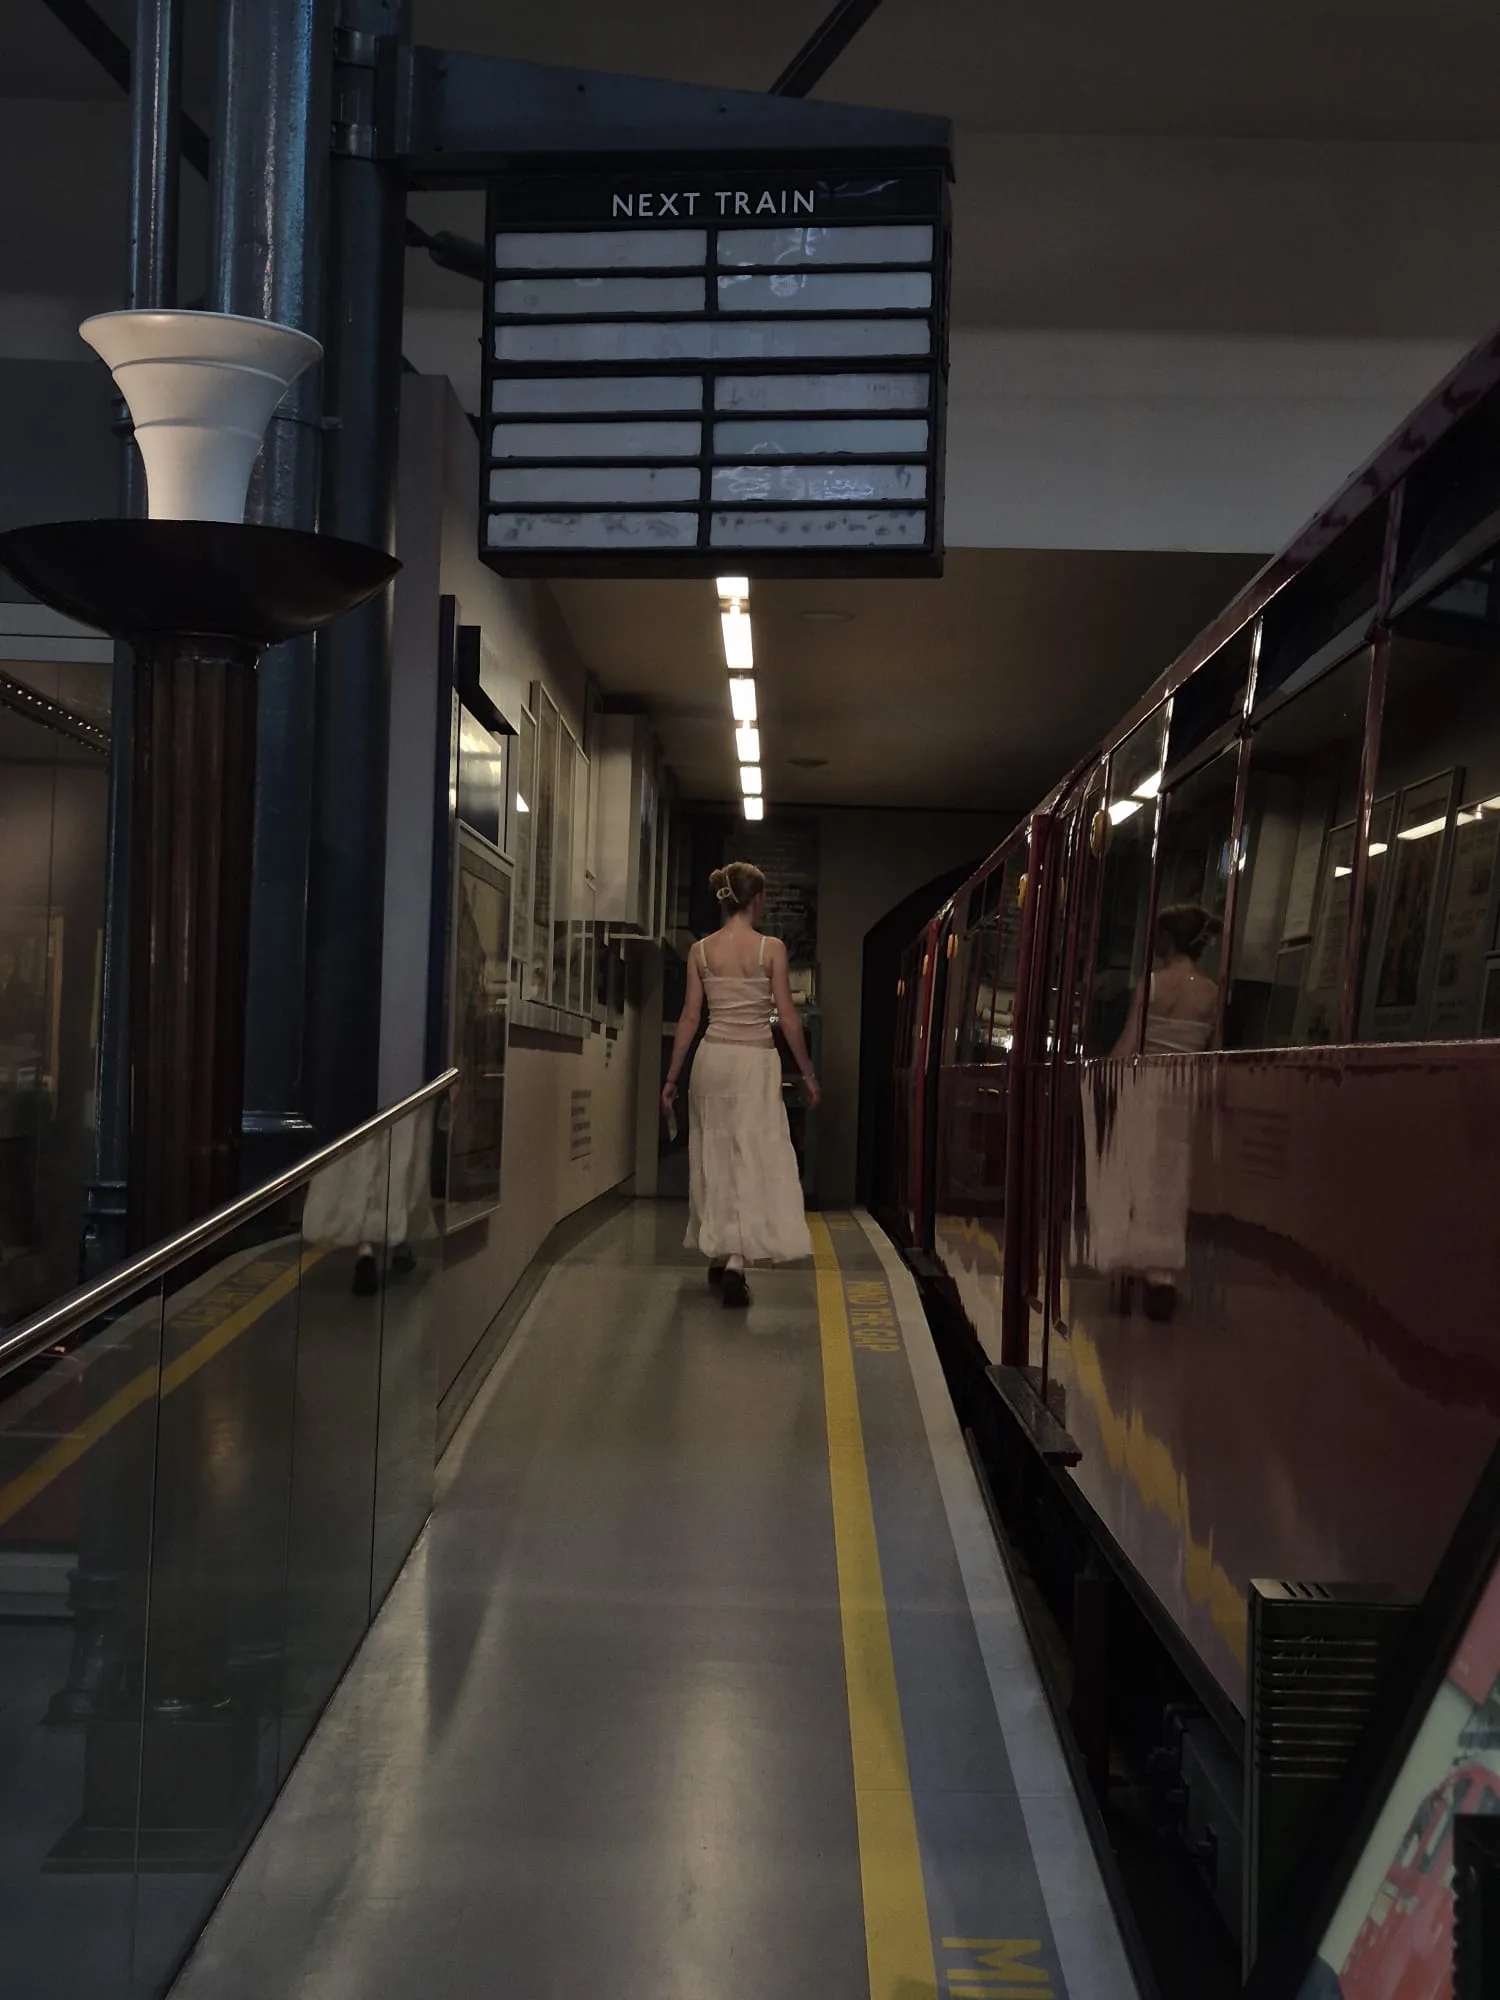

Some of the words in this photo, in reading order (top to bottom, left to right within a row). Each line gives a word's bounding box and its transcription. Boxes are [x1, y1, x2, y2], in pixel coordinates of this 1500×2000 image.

[612, 192, 700, 217] NEXT
[714, 189, 815, 216] TRAIN
[849, 1308, 894, 1326] THE
[853, 1329, 900, 1352] GAP
